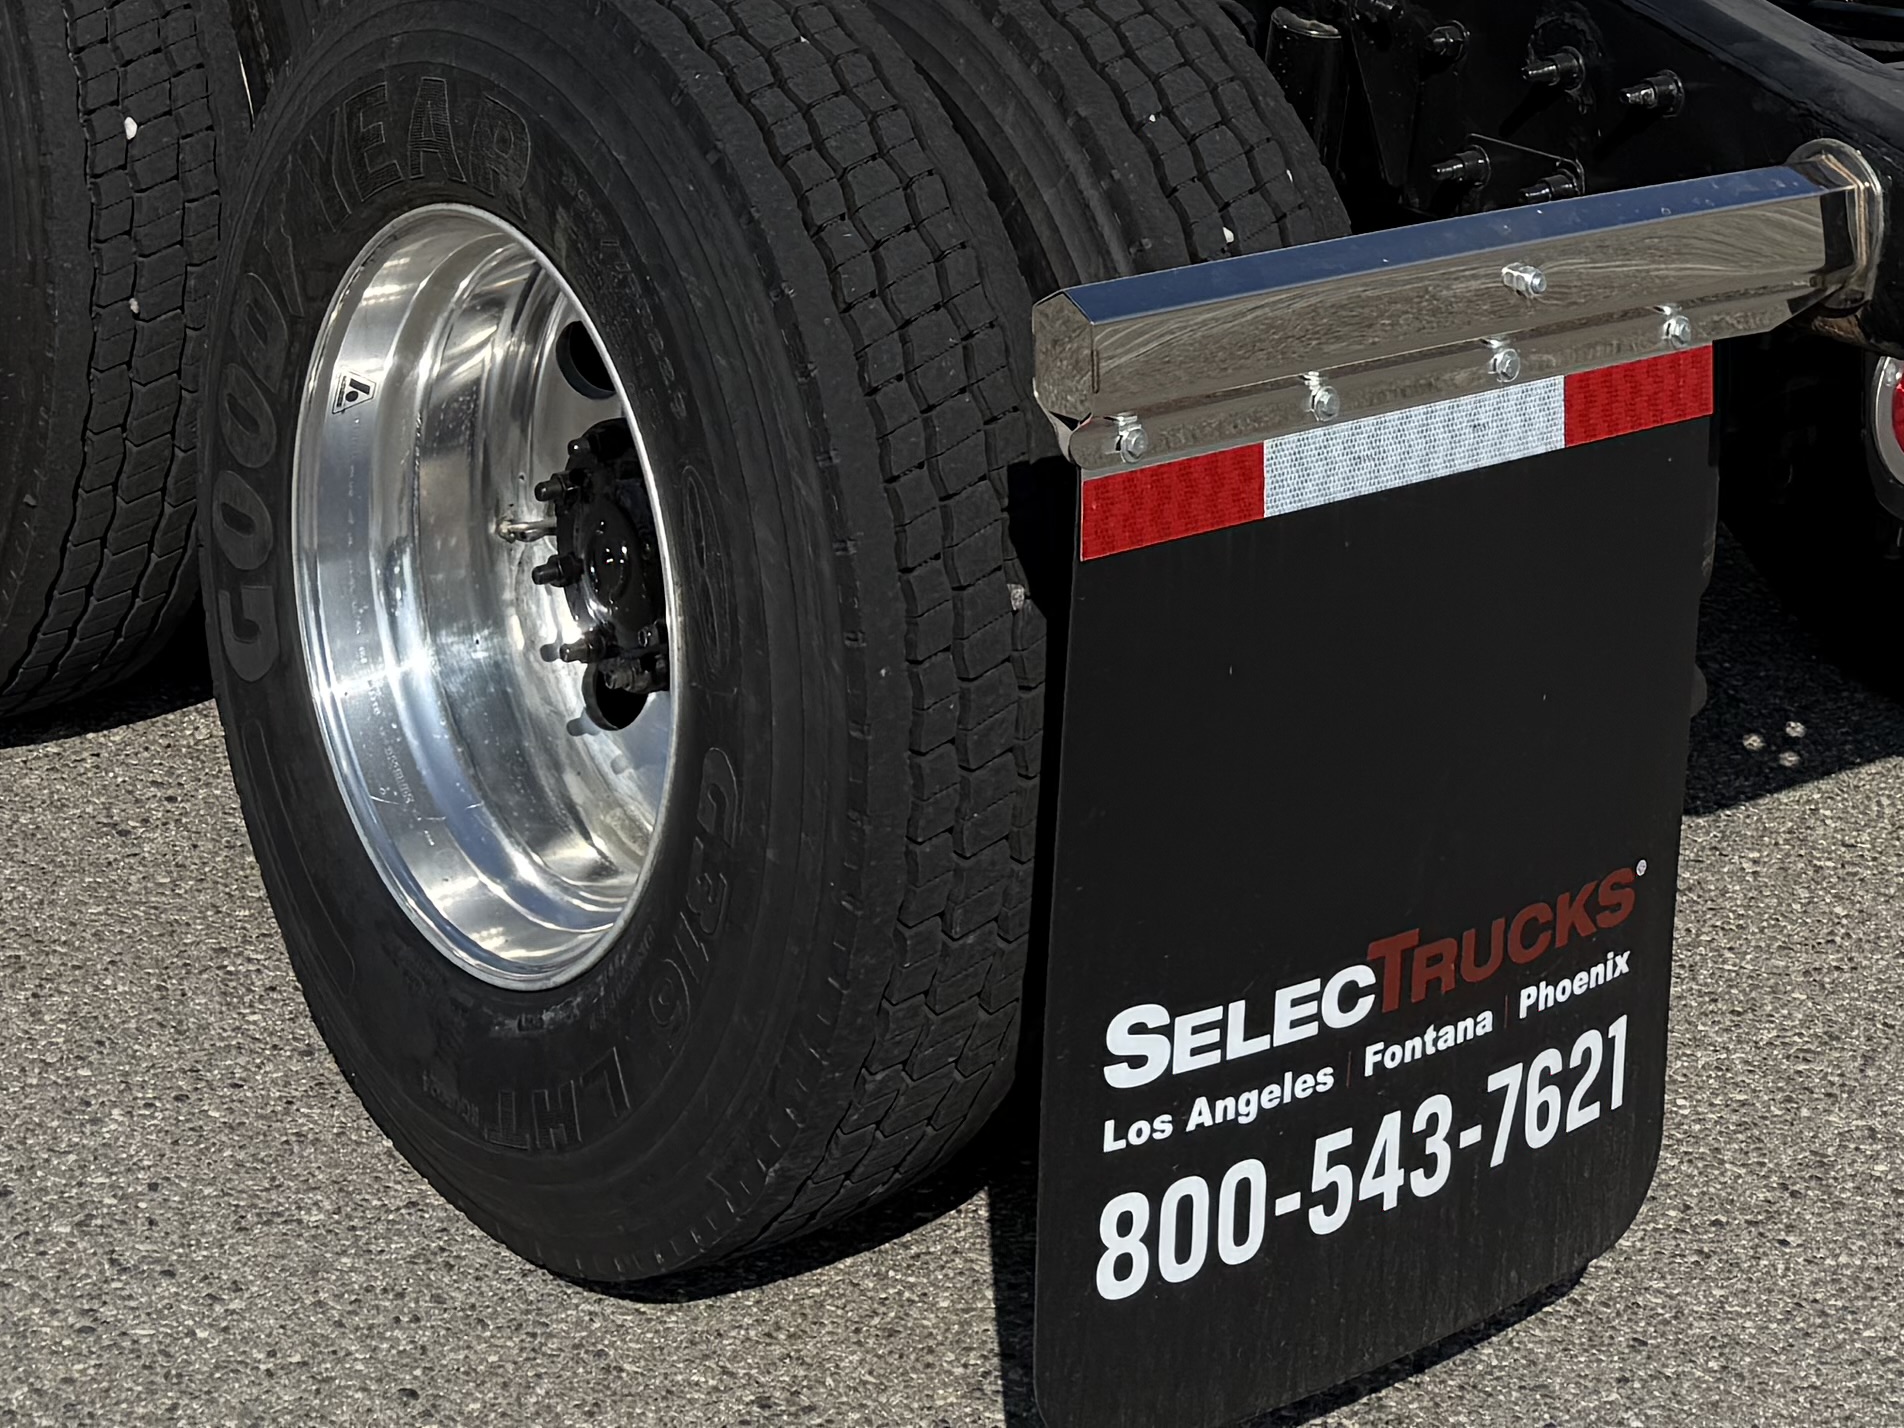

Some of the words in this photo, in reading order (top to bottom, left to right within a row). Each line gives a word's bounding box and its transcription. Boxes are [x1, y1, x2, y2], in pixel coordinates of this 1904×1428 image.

[1096, 1014, 1628, 1301] 800-543-7621
[1102, 1111, 1174, 1153] Los
[1186, 1066, 1335, 1132] Angeles
[1364, 1010, 1493, 1077] Fontana
[1519, 950, 1631, 1019] Phoenix
